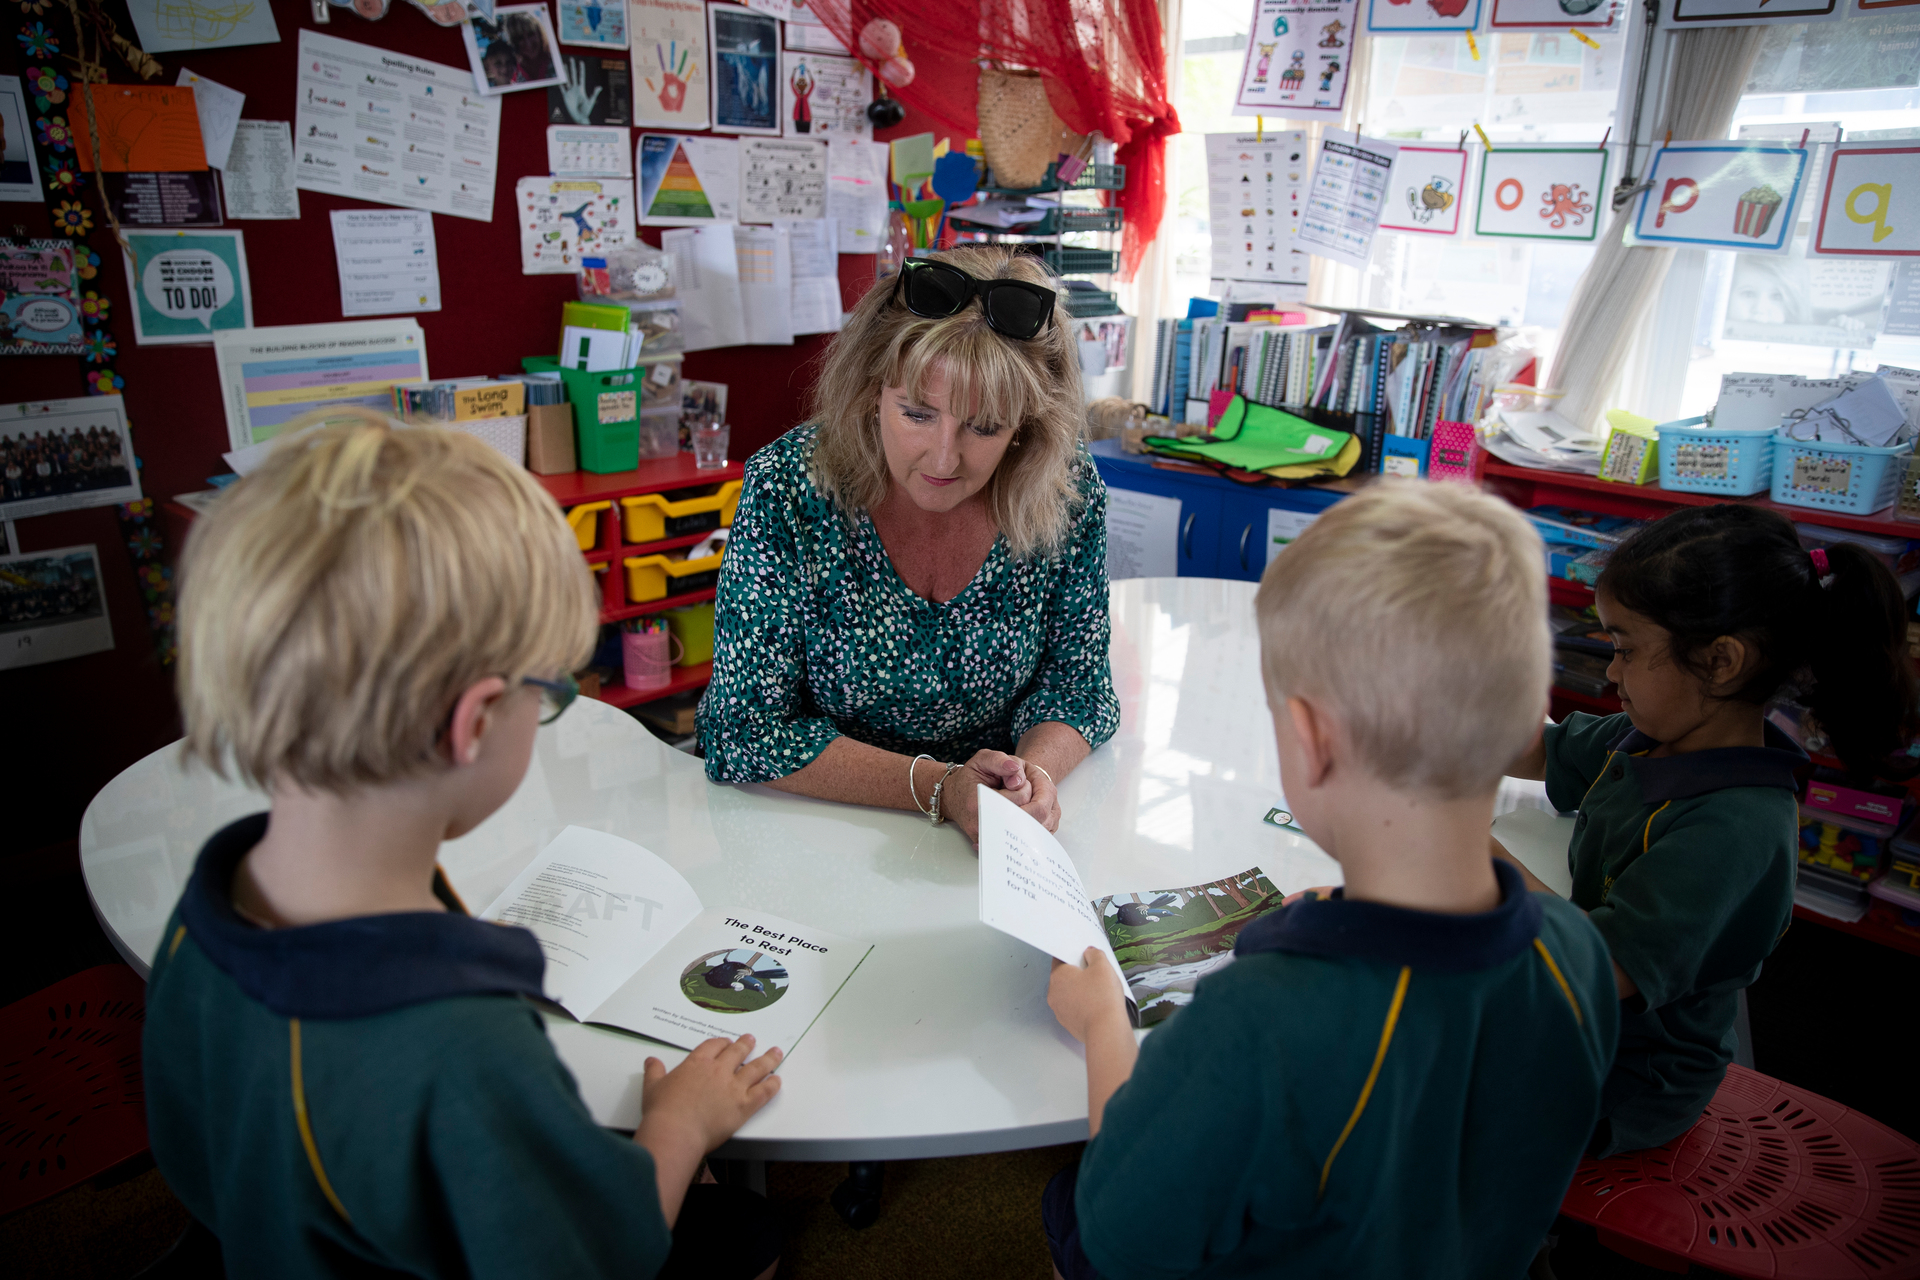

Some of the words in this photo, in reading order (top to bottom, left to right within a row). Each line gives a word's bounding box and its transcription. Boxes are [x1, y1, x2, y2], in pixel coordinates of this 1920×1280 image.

[381, 56, 414, 73] Spelling
[415, 65, 436, 77] Rules
[1494, 178, 1523, 212] o
[1654, 176, 1700, 229] p
[1844, 182, 1894, 243] q
[163, 287, 185, 310] TO
[190, 286, 218, 310] DO!
[250, 346, 264, 355] THE
[265, 345, 299, 354] BUILDING
[300, 342, 326, 351] BLOCKS
[327, 342, 337, 350] OF
[338, 339, 367, 348] READING
[368, 337, 396, 346] SUCCESS
[478, 388, 508, 403] Long
[470, 401, 504, 415] Swim
[18, 635, 31, 648] 19
[1005, 854, 1022, 868] the
[1066, 890, 1085, 907] says
[1006, 879, 1021, 892] for
[1006, 866, 1036, 887] Frog's
[1038, 883, 1065, 904] home
[1067, 901, 1076, 911] is
[1077, 908, 1092, 922] too
[724, 917, 749, 930] The
[752, 925, 786, 941] Best
[787, 936, 828, 954] Place
[739, 934, 755, 945] to
[757, 940, 792, 957] Rest
[652, 1006, 672, 1017] Written
[679, 1015, 707, 1028] Samantha
[707, 1024, 742, 1038] Montgomeri
[653, 1014, 681, 1027] Illustrated
[680, 1022, 688, 1030] by
